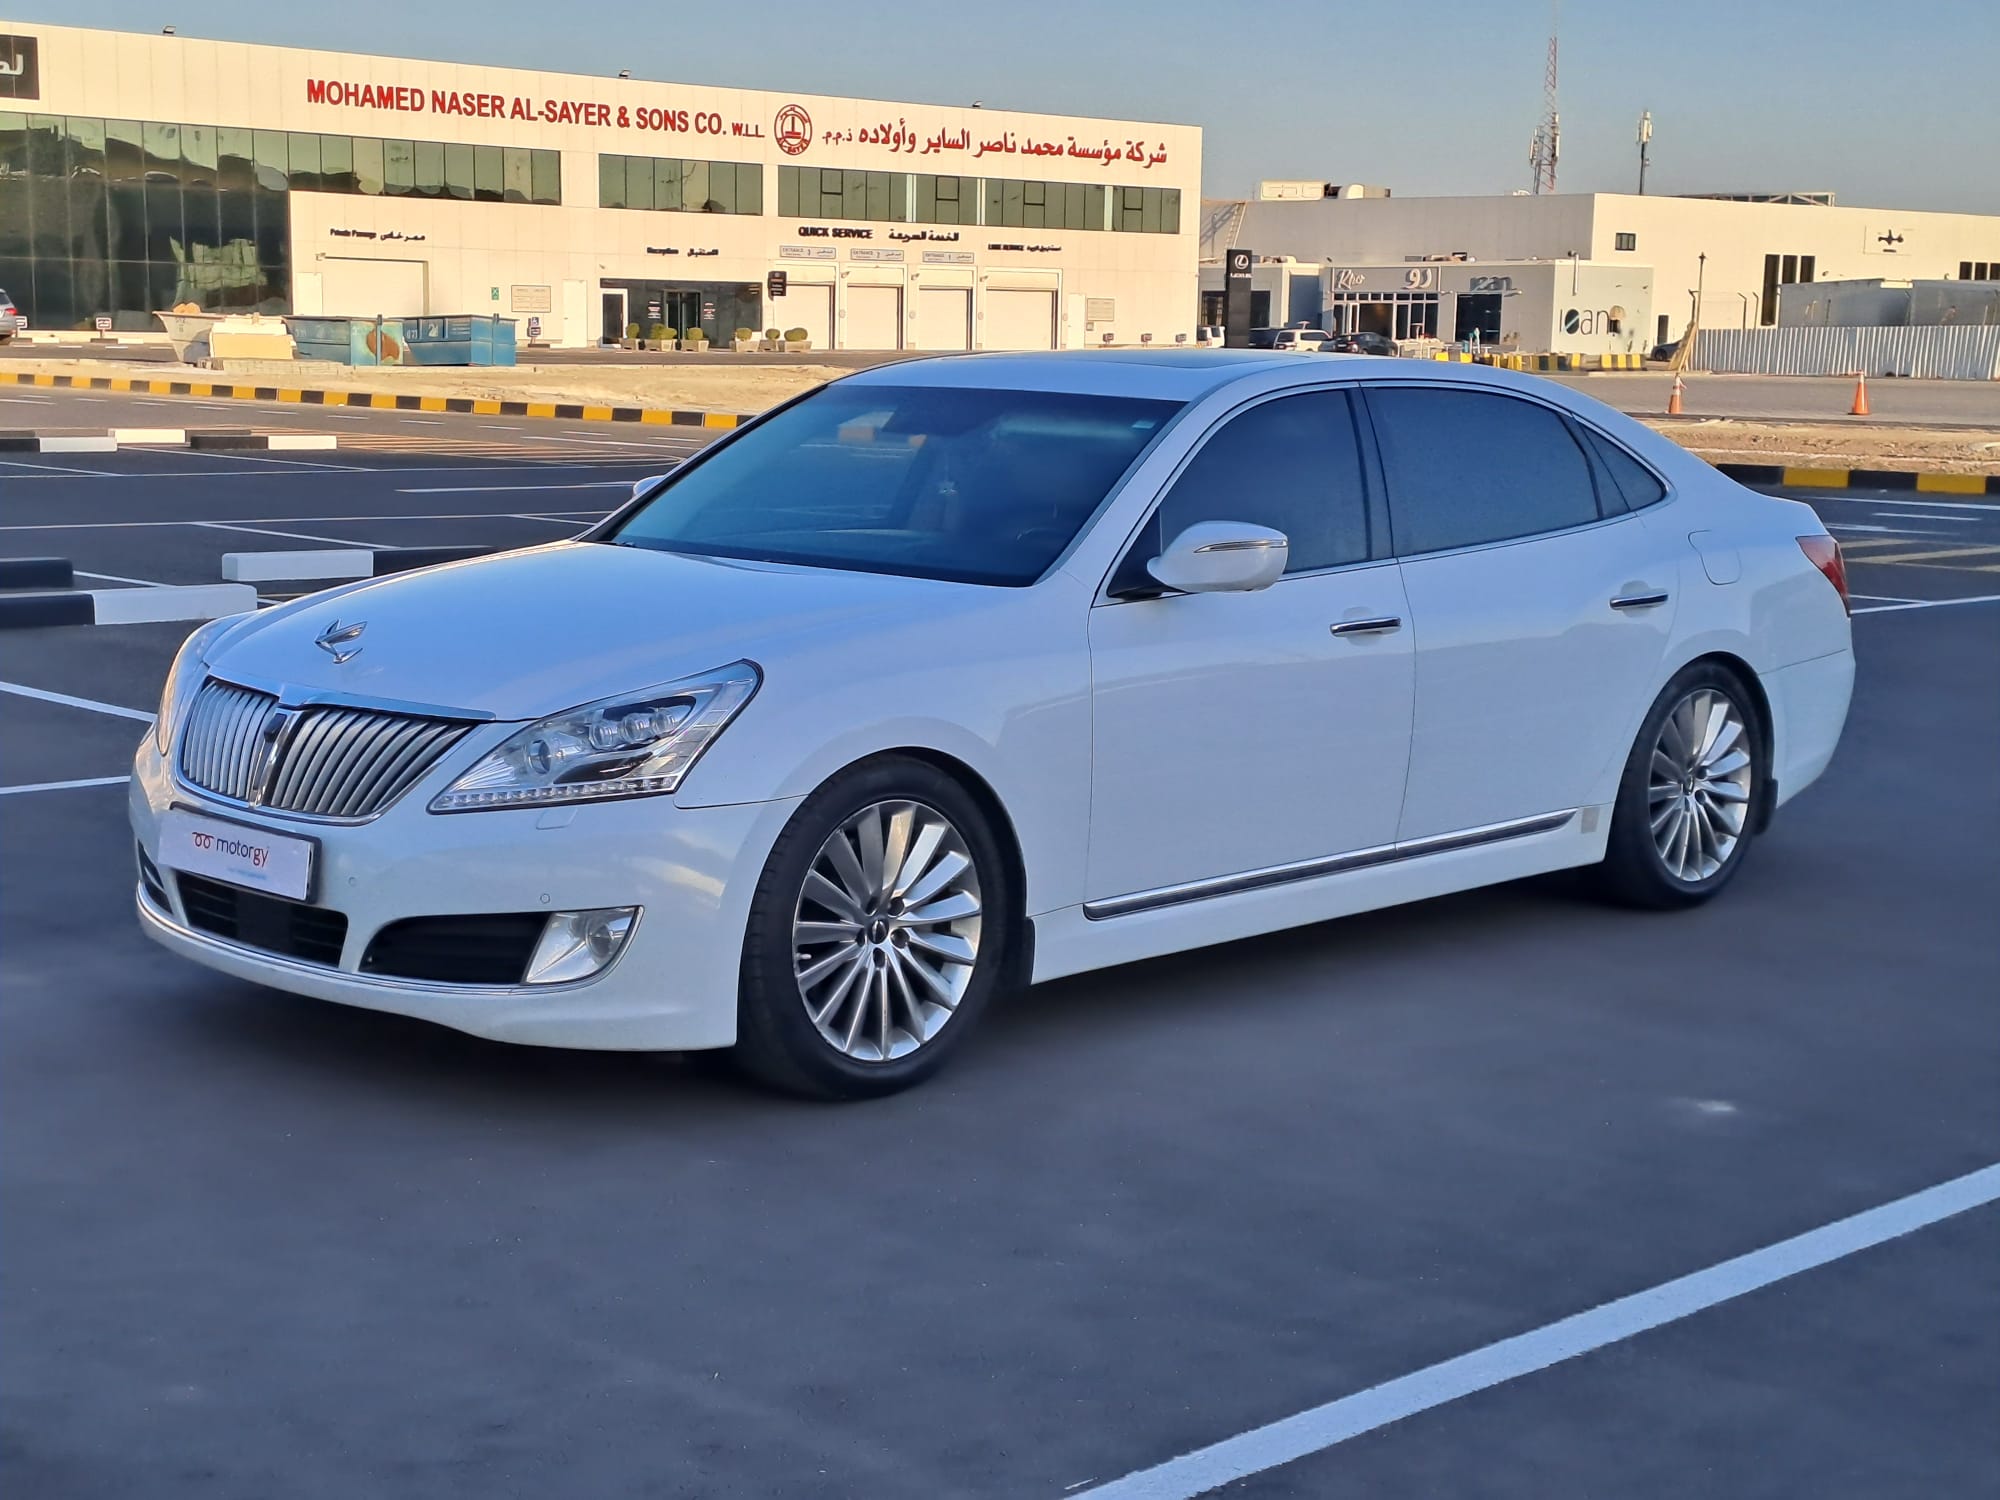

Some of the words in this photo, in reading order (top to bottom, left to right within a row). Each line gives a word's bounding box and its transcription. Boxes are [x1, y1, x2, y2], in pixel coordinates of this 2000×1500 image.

[306, 78, 425, 112] MOHAMED
[431, 90, 506, 119] NASER
[510, 97, 611, 127] AL-SAYER
[616, 105, 631, 129] &
[635, 106, 690, 133] SONS
[694, 111, 727, 135] CO.
[858, 117, 917, 153] وأولاده
[919, 127, 971, 154] الساير
[972, 131, 1017, 158] ناصر
[1020, 137, 1064, 158] محمد
[1067, 136, 1122, 166] مؤسسة
[1125, 140, 1168, 169] شركة
[798, 226, 829, 238] QUICK
[831, 227, 873, 239] SERVICE
[215, 837, 269, 868] motorgy
